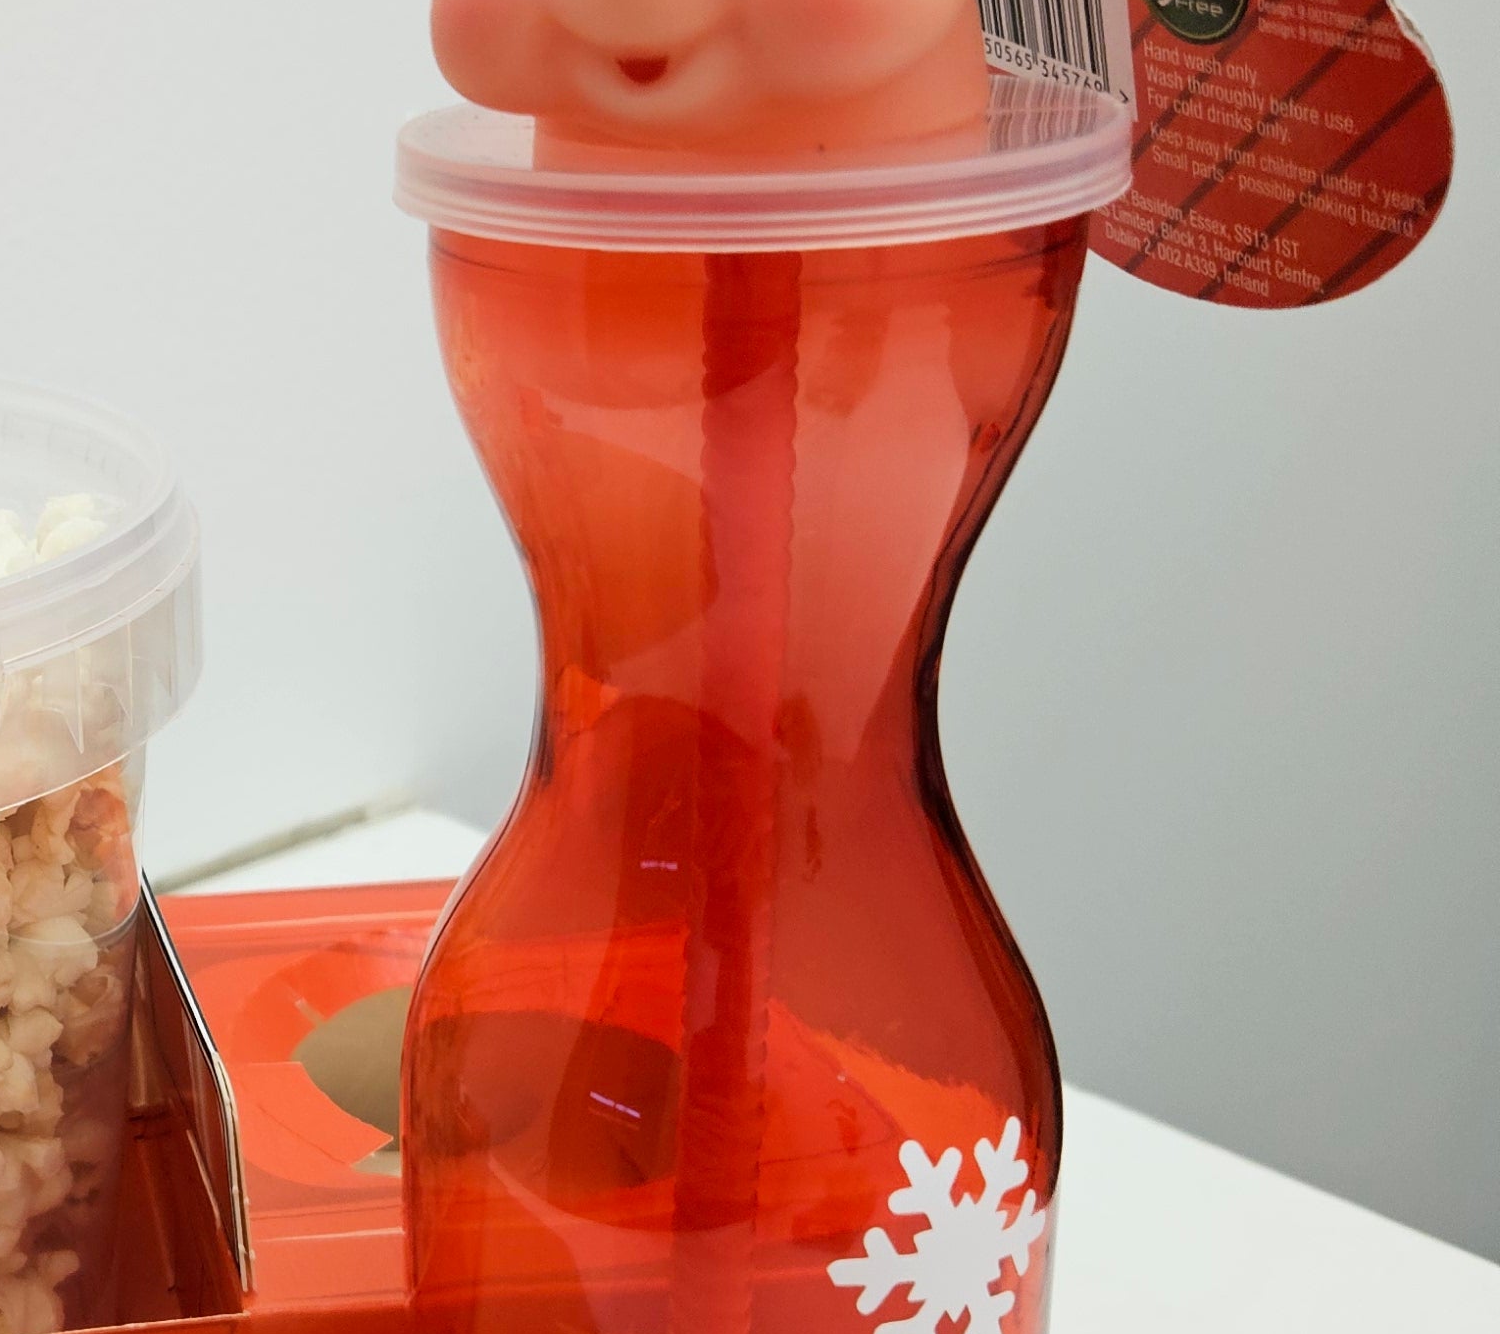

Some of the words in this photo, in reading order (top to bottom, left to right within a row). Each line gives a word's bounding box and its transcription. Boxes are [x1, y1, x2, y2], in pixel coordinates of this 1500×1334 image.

[1143, 38, 1179, 65] Hand
[1183, 52, 1222, 76] wash
[1145, 63, 1183, 91] Wash
[1187, 75, 1264, 114] thoroughly
[1270, 95, 1319, 125] before
[1147, 87, 1169, 110] For
[1173, 97, 1202, 119] cold
[1207, 105, 1252, 133] drinks
[1257, 119, 1292, 143] only.
[1150, 121, 1183, 147] Keep
[1187, 135, 1220, 161] away
[1224, 142, 1256, 168] from
[1259, 154, 1317, 183] children
[1321, 173, 1363, 197] under
[1368, 182, 1378, 203] 3
[1152, 145, 1188, 170] Small
[1192, 160, 1225, 183] parts
[1238, 174, 1296, 205] possible
[1299, 190, 1357, 227] choking
[1361, 206, 1417, 240] hazard.
[1105, 221, 1141, 251] Dublin
[1184, 253, 1222, 283] A339,
[1223, 264, 1270, 297] Ireland
[1131, 190, 1187, 225] Basildon,
[1189, 210, 1232, 241] Essex,
[1233, 223, 1269, 250] SS13
[1273, 238, 1301, 259] 1ST
[1161, 221, 1196, 249] Block
[1198, 235, 1212, 257] 3,
[1214, 240, 1272, 275] Harcourt
[1274, 260, 1325, 294] Centre,
